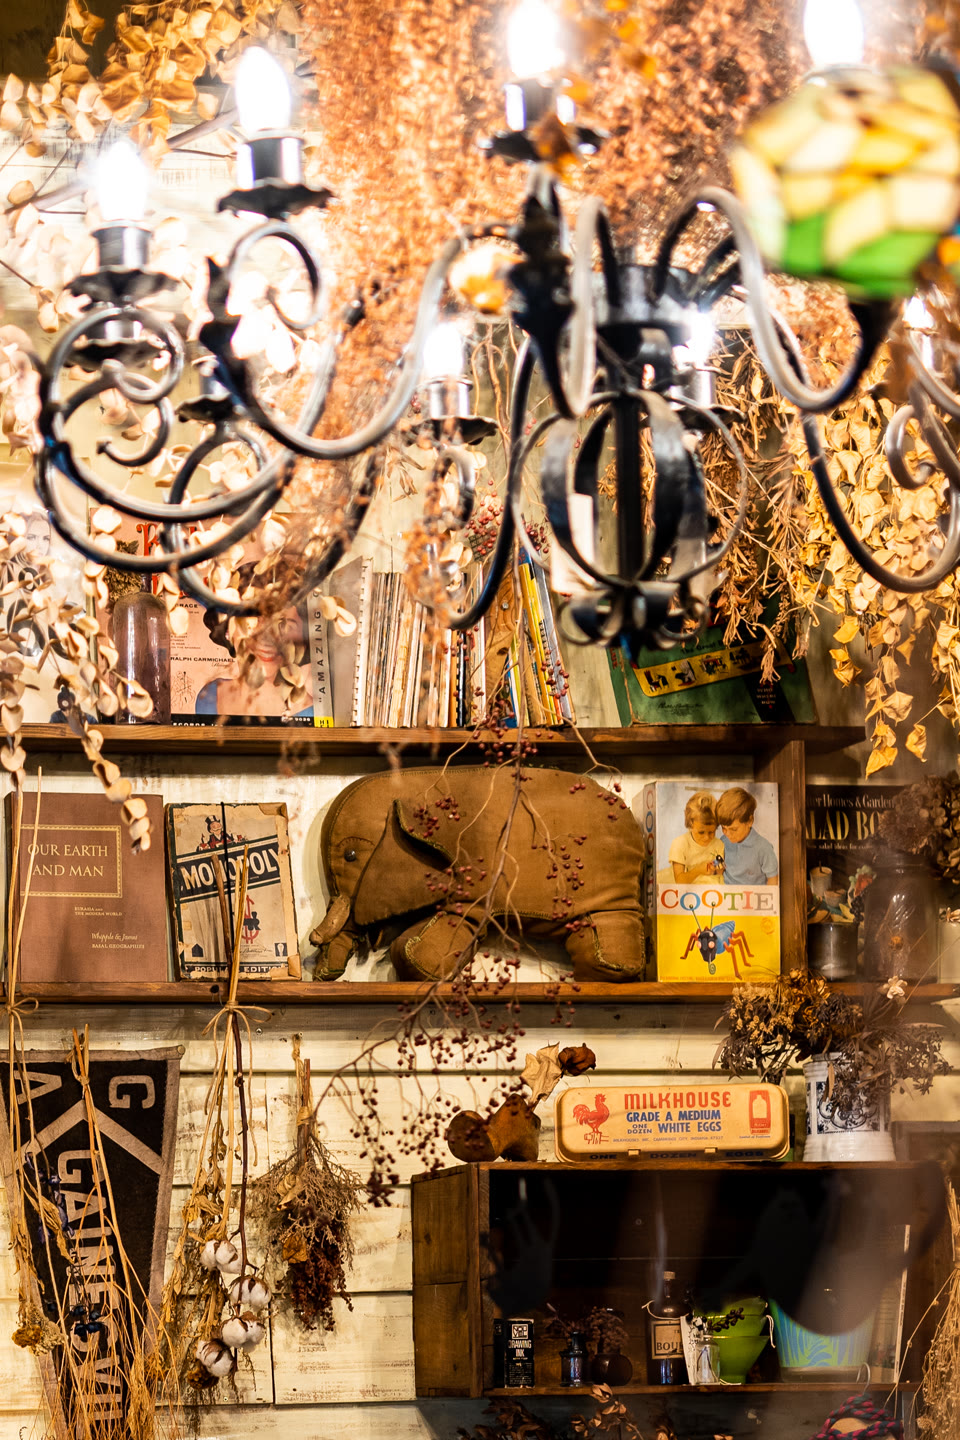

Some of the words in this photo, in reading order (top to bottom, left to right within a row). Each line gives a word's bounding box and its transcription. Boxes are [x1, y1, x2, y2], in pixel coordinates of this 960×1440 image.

[823, 793, 854, 807] Homes
[855, 796, 862, 808] &
[862, 794, 896, 808] Garden
[27, 843, 60, 856] OUR
[64, 844, 108, 857] EARTH
[645, 789, 655, 909] COOTIE
[32, 864, 65, 876] AND
[69, 865, 104, 877] MAN
[660, 888, 774, 911] COOTIE
[624, 1091, 732, 1110] MILKHOUSE
[626, 1111, 661, 1123] GRADE
[665, 1111, 673, 1121] A
[678, 1110, 721, 1121] MEDIUM
[658, 1122, 691, 1133] WHITE
[697, 1121, 722, 1132] EGGS
[508, 1339, 532, 1348] DRAWING
[515, 1349, 525, 1357] INK
